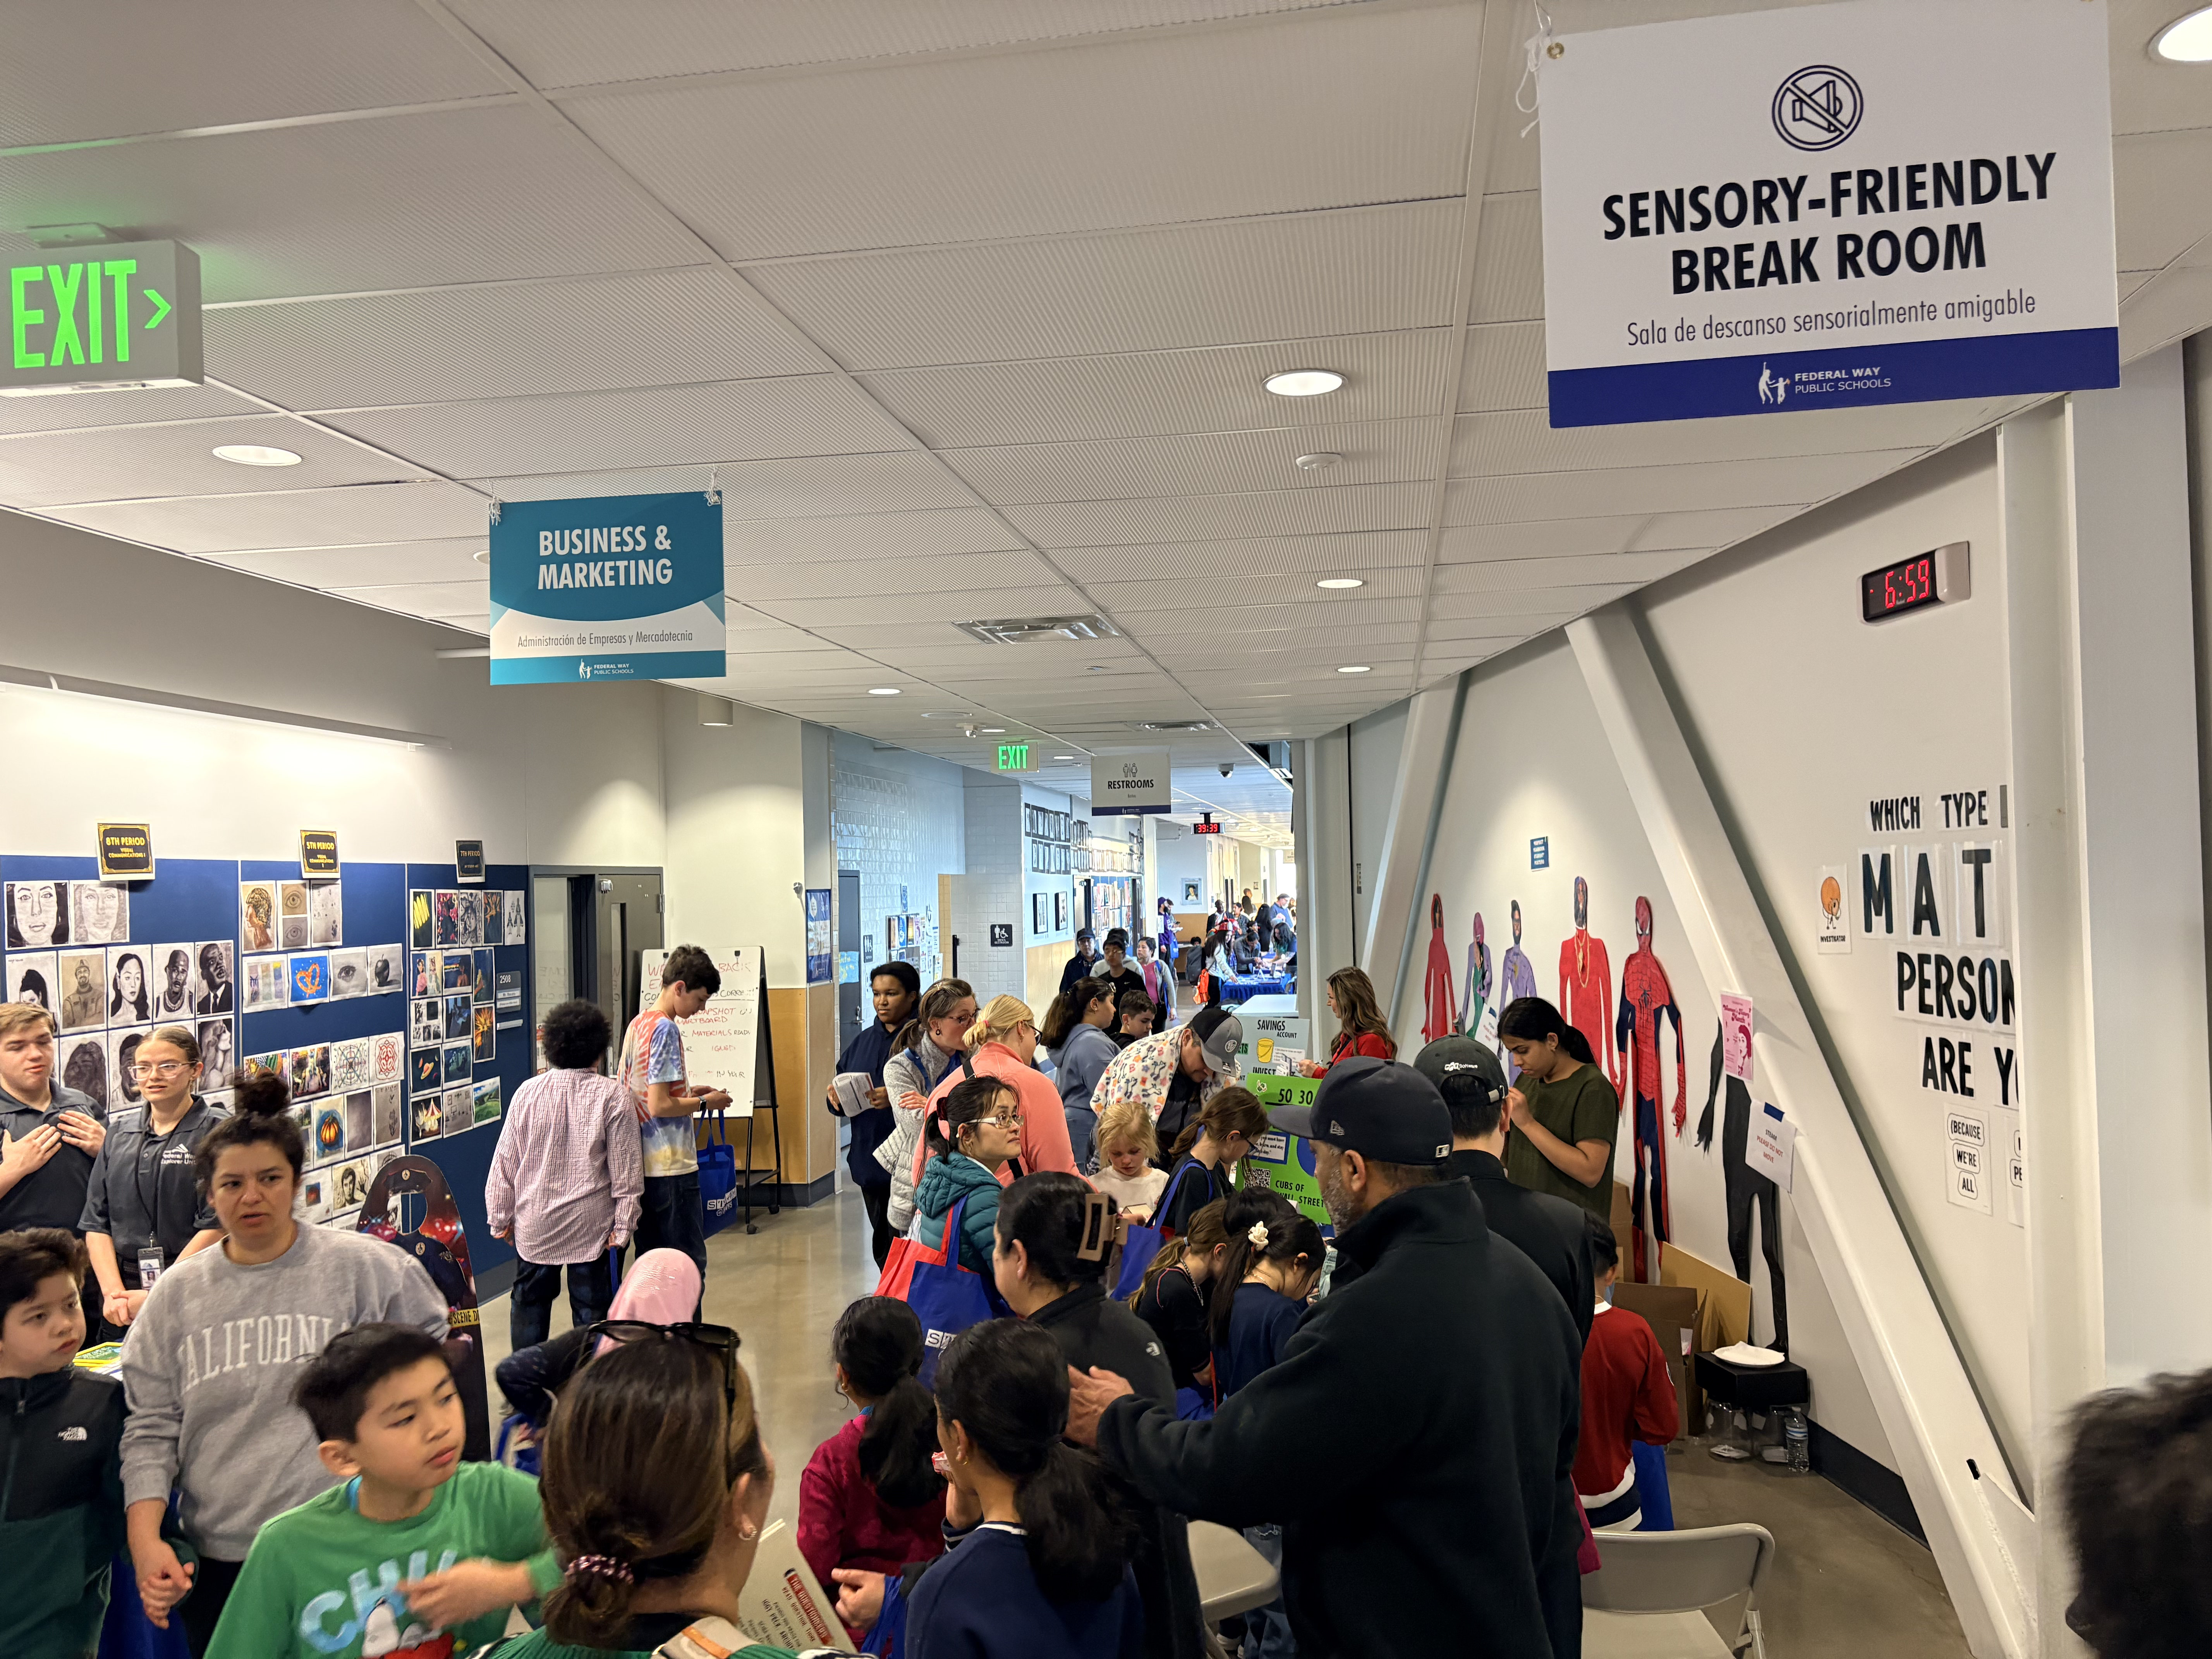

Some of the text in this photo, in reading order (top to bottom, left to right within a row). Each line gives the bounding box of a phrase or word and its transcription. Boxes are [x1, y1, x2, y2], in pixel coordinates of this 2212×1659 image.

[1602, 152, 2057, 240] SENSORY-FRIENDLY
[1672, 222, 1987, 295] BREAK ROOM
[11, 259, 136, 369] EXIT
[1627, 289, 2036, 346] Sala de descanso sensorialmente amigable
[1795, 367, 1881, 382] FEDERAL WAY
[1795, 378, 1892, 394] PUBLIC SCHOOLS
[539, 525, 672, 556] BUSINESS &
[538, 558, 673, 590] MARKETING
[1885, 560, 1929, 608] 6:59
[518, 630, 693, 647] Administración de Empresas y Mercadotecnia
[998, 745, 1029, 769] EXIT
[1108, 779, 1154, 789] RESTROOMS
[1870, 790, 1988, 832] WHICH TYPE
[106, 837, 145, 846] 8TH PERIOD
[317, 842, 335, 850] PERIOD
[1257, 1020, 1285, 1031] SAVINGS
[1922, 1036, 2019, 1106] ARE Y
[1278, 1089, 1313, 1105] 50 30
[1951, 1120, 1981, 1140] (BECAUSE
[1769, 1143, 1775, 1152] DO
[1956, 1149, 1977, 1167] WE'RE
[1276, 1180, 1305, 1192] CUBS OF
[1962, 1177, 1975, 1193] ALL
[1298, 1195, 1323, 1207] STREET
[453, 1310, 471, 1324] SCENE
[178, 1314, 350, 1395] ALIFORNI
